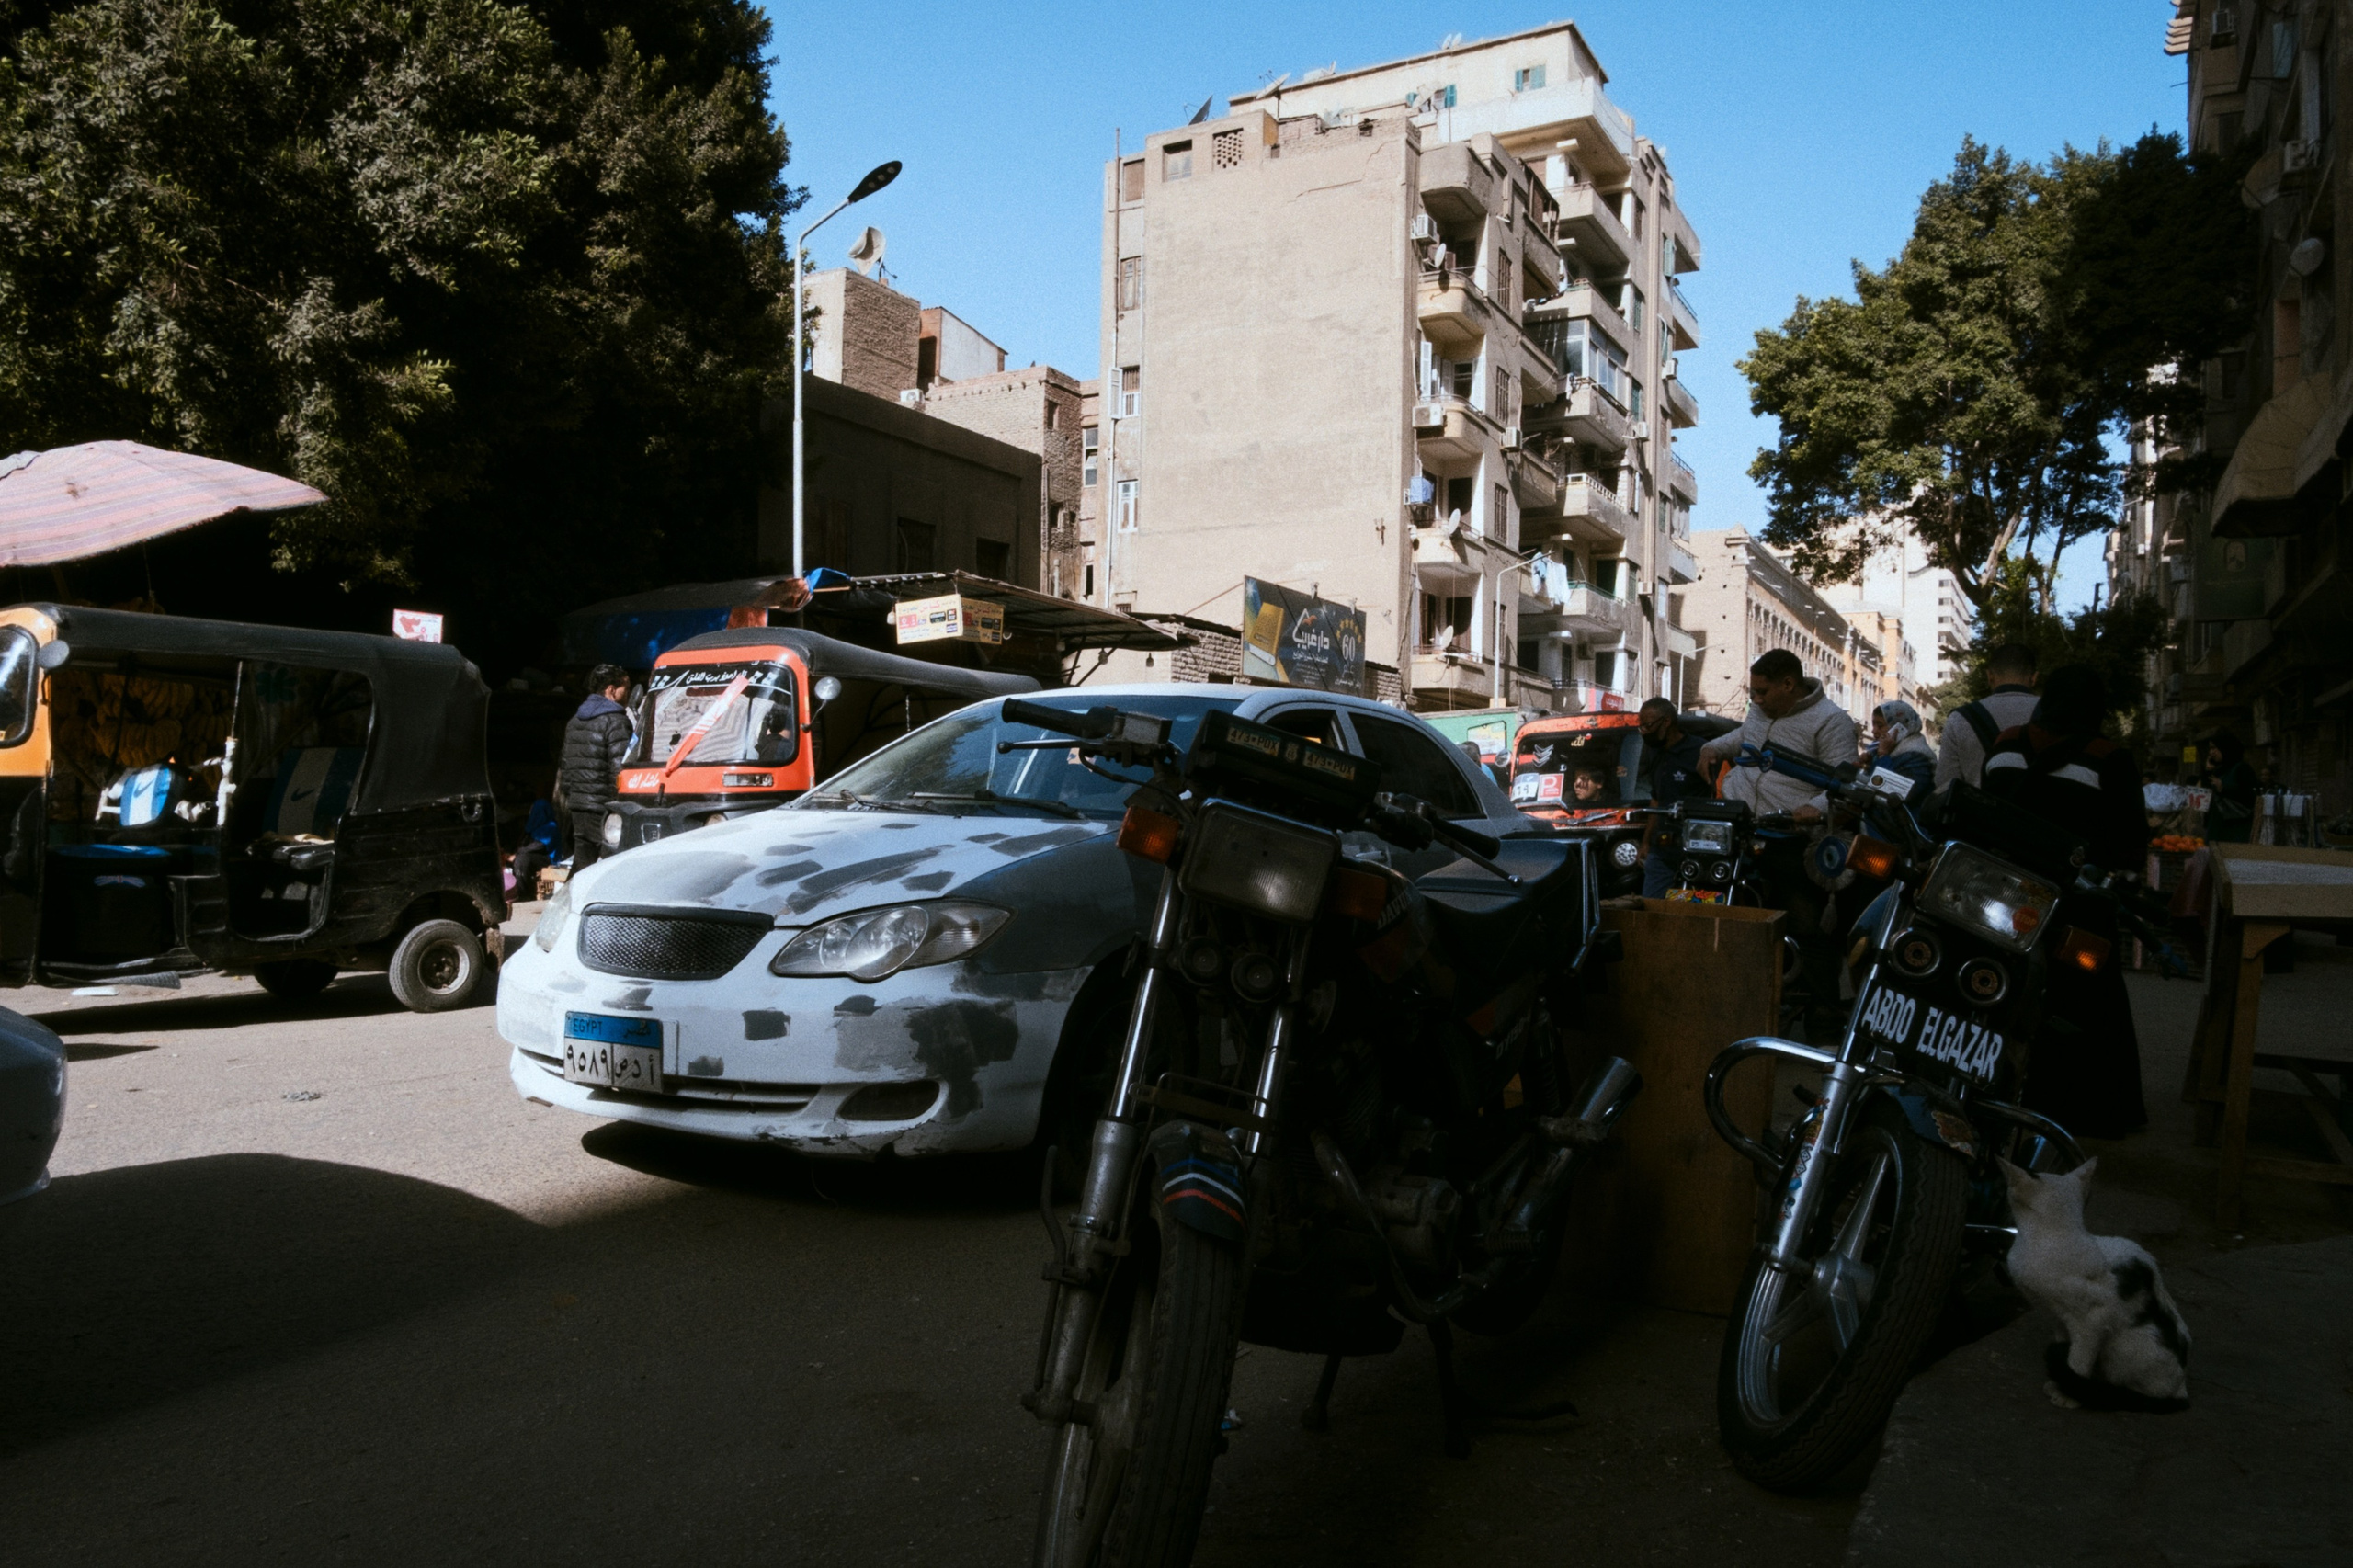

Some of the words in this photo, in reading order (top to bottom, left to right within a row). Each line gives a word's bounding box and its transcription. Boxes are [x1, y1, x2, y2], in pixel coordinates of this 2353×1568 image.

[1342, 634, 1356, 662] 60
[574, 1018, 603, 1035] EGYPT
[1861, 985, 1916, 1044] ABDO
[1915, 1006, 2003, 1083] ELGAZAR
